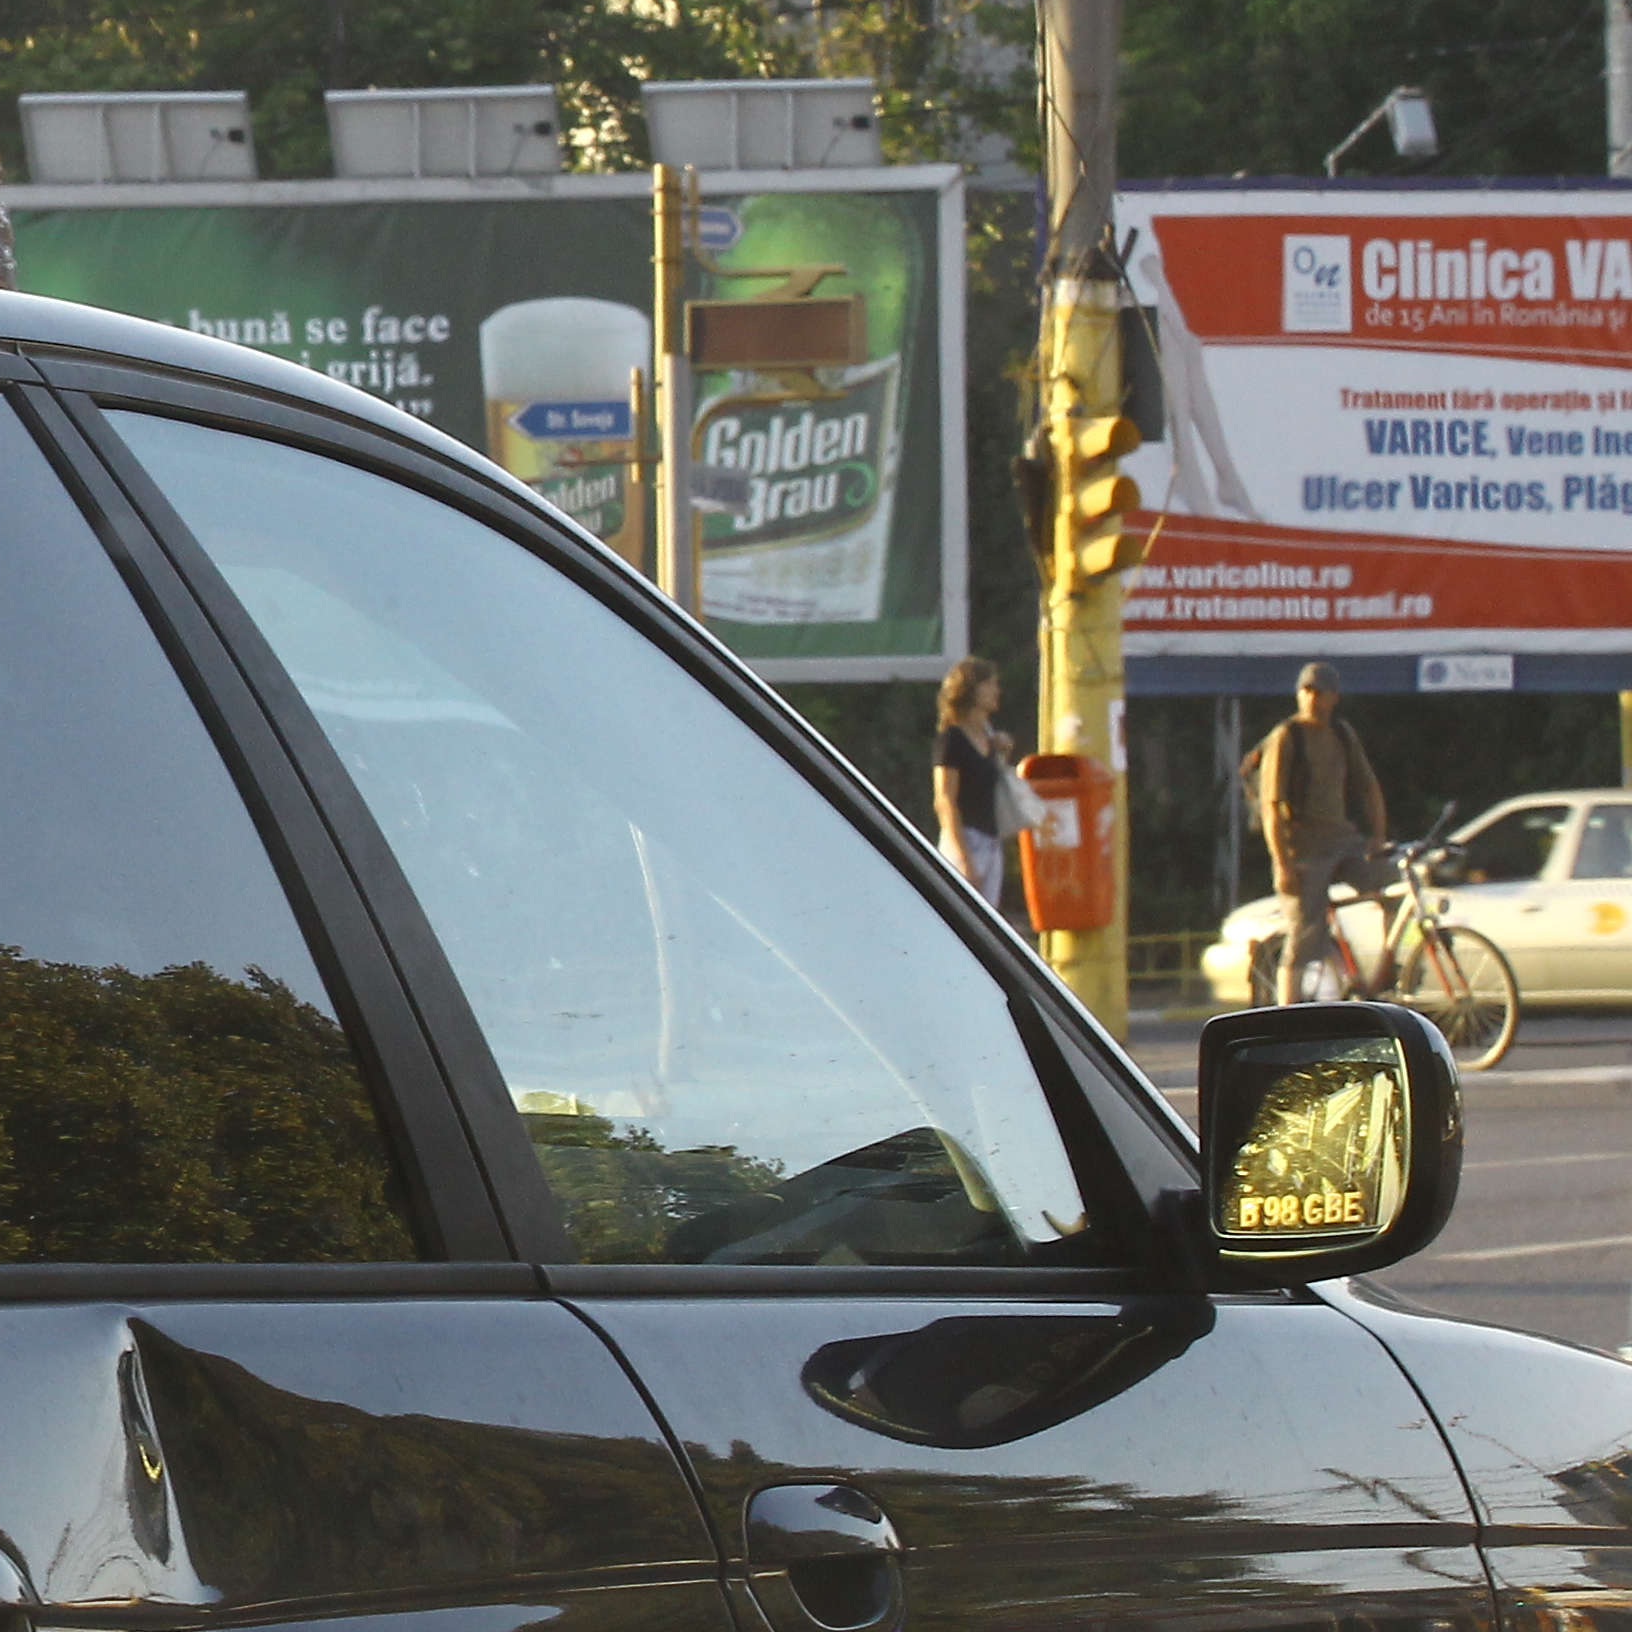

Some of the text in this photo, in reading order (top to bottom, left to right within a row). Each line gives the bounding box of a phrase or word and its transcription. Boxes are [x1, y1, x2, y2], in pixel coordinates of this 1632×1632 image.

[1361, 237, 1555, 301] Clinica
[1564, 238, 1632, 301] VA
[188, 305, 451, 346] bună se face
[1365, 303, 1392, 327] de
[1399, 307, 1425, 333] 15
[1429, 303, 1469, 327] Ani
[1498, 301, 1604, 328] România
[1340, 387, 1447, 410] Tratament
[705, 411, 870, 474] Golden
[1364, 418, 1497, 461] VARICE,
[1504, 424, 1585, 457] Vene
[533, 474, 616, 512] olden
[1301, 474, 1402, 511] Ulcer
[1409, 473, 1553, 516] Varicos,
[1239, 1190, 1365, 1228] B 98 GBE
